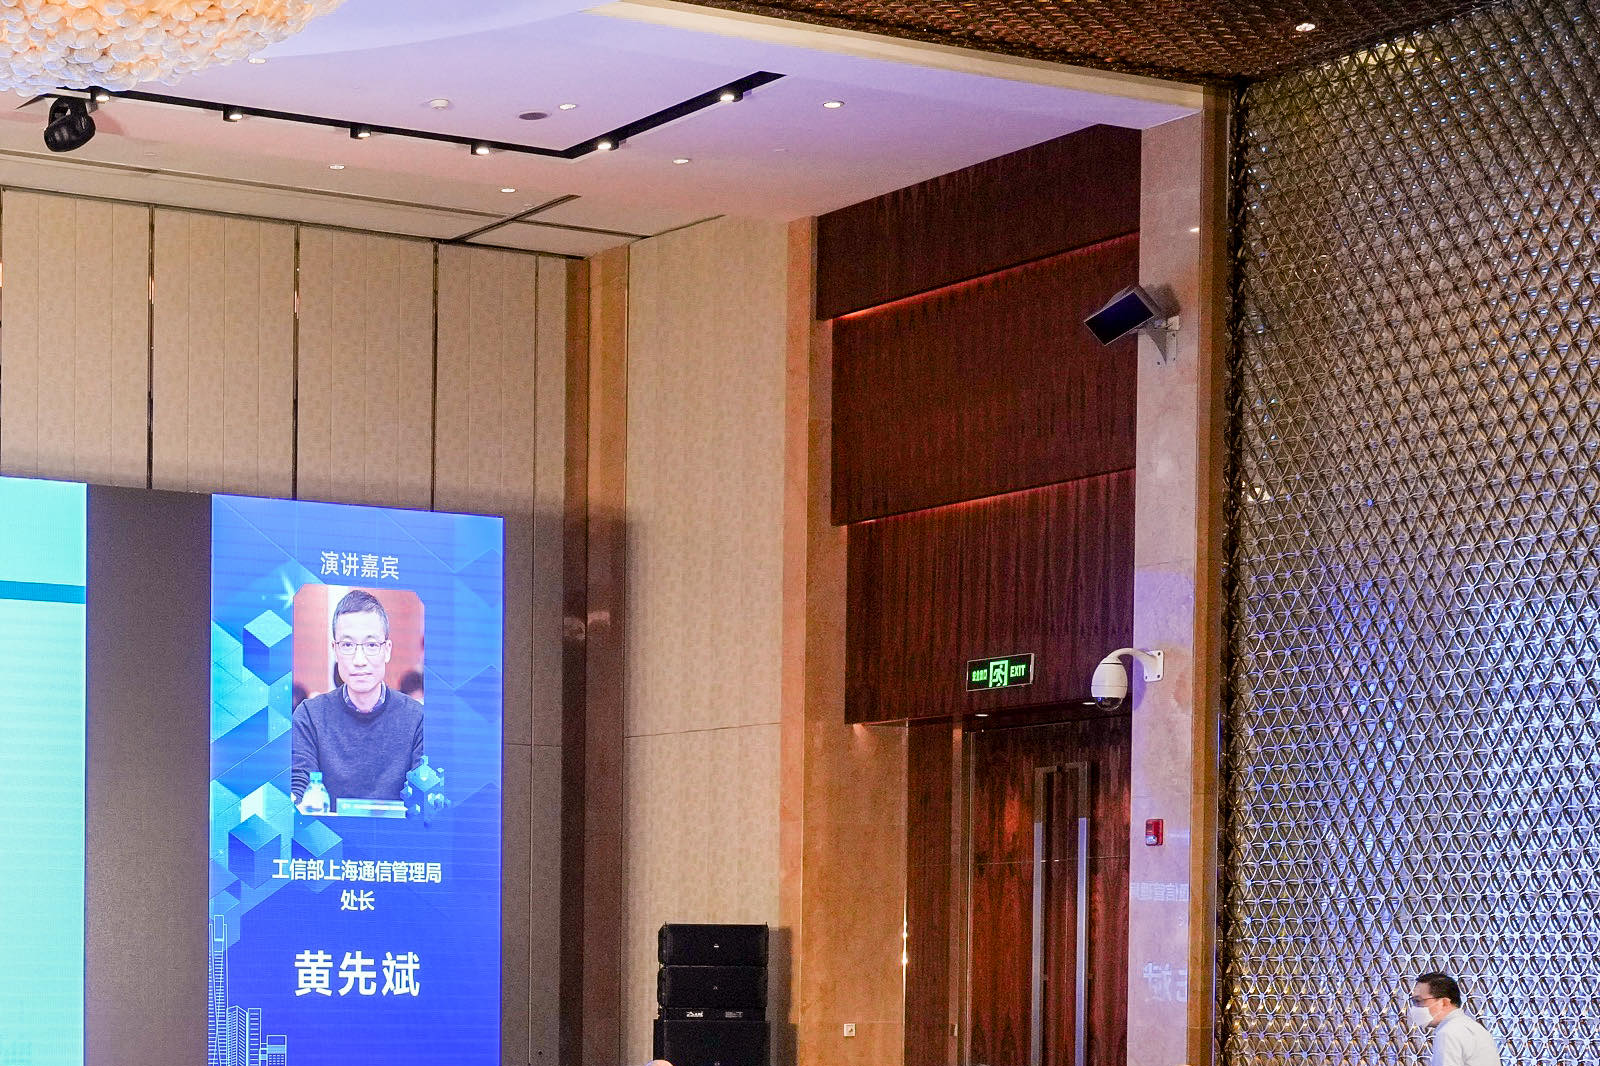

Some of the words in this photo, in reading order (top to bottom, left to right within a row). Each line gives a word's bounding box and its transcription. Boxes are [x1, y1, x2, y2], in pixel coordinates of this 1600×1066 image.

[320, 551, 400, 580] 演讲嘉宾
[1010, 664, 1026, 678] EXIT
[272, 858, 442, 884] 工信部上海通信管理局
[340, 889, 376, 912] 处长
[294, 949, 421, 998] 黄先斌
